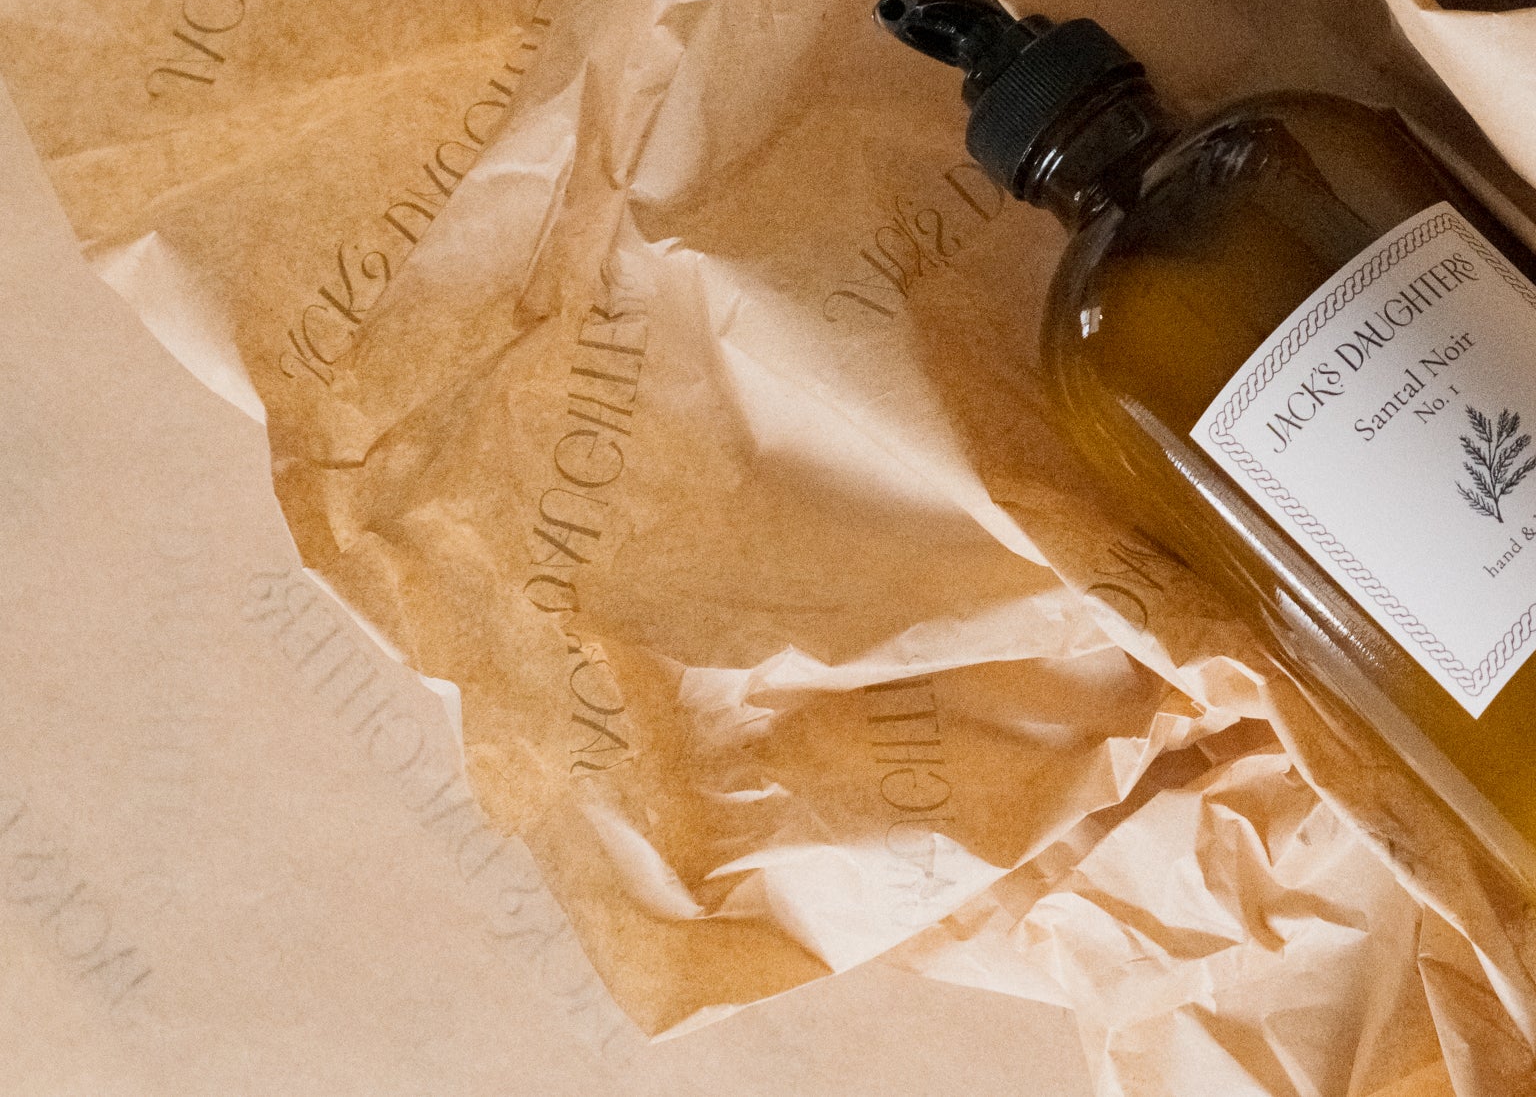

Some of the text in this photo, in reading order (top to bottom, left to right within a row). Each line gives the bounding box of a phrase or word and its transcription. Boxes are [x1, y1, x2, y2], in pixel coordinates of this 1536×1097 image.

[1266, 252, 1480, 454] JACK'S DAUGHTERS
[1354, 332, 1475, 441] Santal Noir
[1412, 398, 1450, 424] No.
[1483, 537, 1523, 578] hand
